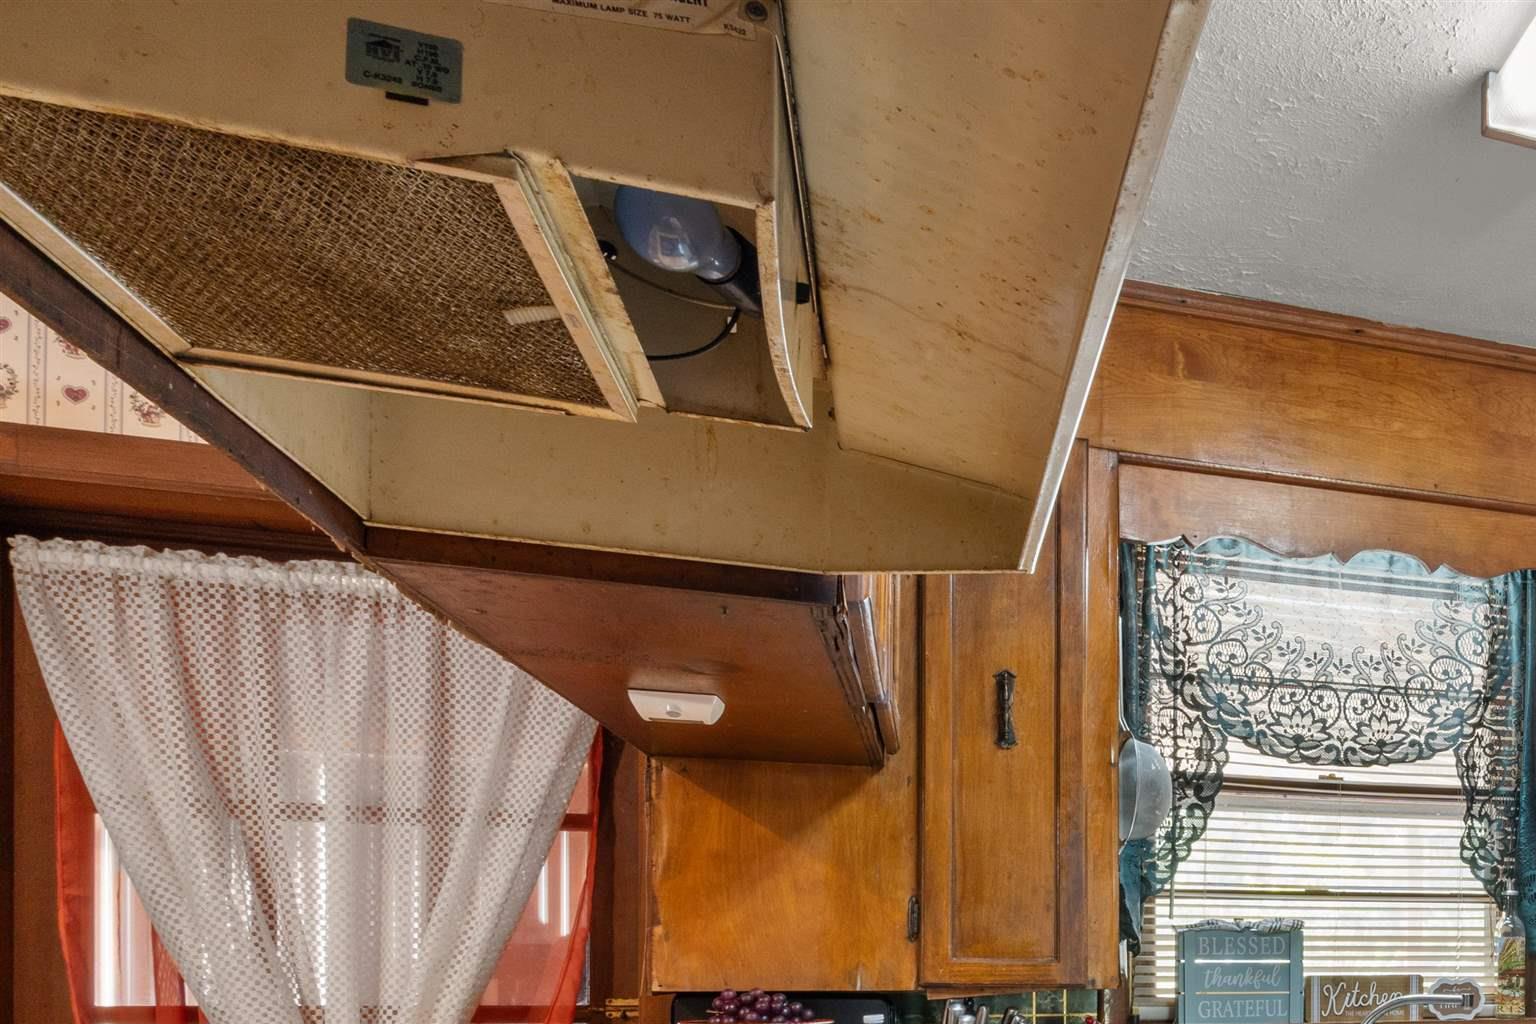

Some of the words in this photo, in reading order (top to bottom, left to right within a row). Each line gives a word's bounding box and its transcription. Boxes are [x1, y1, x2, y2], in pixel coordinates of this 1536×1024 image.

[601, 5, 625, 13] LAMP
[628, 8, 648, 18] SIZE
[665, 14, 690, 23] WATT
[1199, 937, 1286, 955] BLESSED
[1204, 966, 1281, 989] thankful
[1198, 1000, 1288, 1018] GRATEFUL
